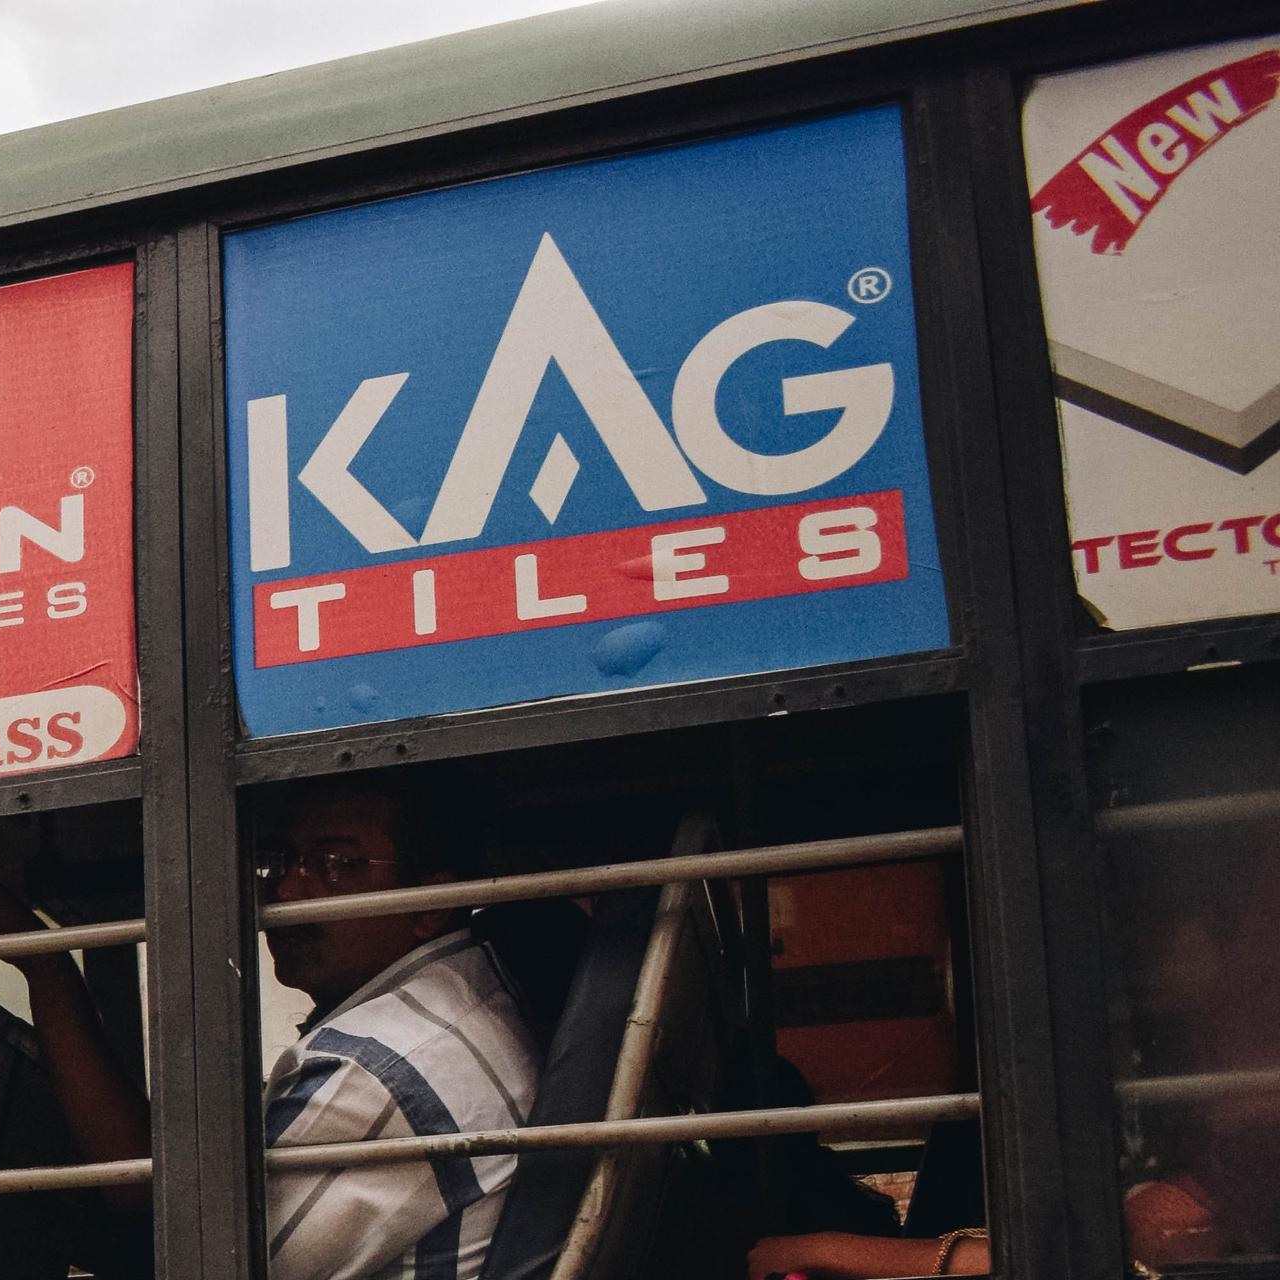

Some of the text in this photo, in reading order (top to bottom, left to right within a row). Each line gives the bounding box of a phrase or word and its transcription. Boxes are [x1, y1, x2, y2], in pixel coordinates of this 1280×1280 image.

[1078, 78, 1243, 226] New
[247, 231, 894, 573] KAG
[269, 506, 883, 653] TILES
